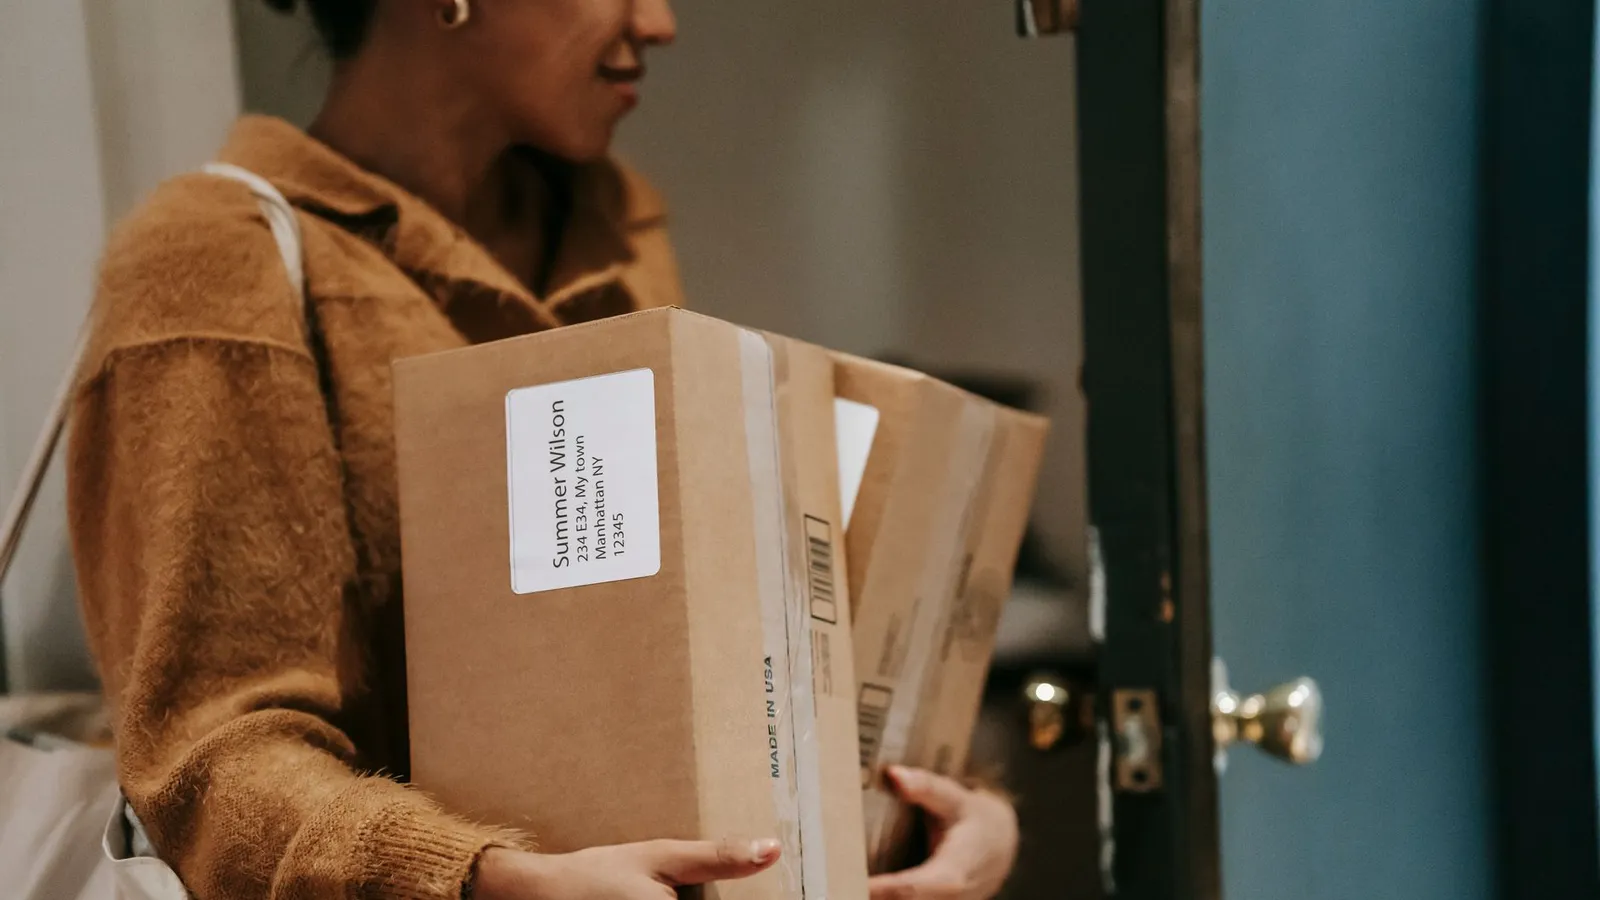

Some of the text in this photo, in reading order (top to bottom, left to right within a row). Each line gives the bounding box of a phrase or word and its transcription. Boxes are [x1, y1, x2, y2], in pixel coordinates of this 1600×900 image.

[548, 400, 570, 568] Summer Wilson
[574, 435, 589, 562] 234 E34, My town
[592, 456, 606, 560] Manhattan NY
[612, 513, 625, 556] 12345
[764, 656, 779, 778] MADE IN USA
